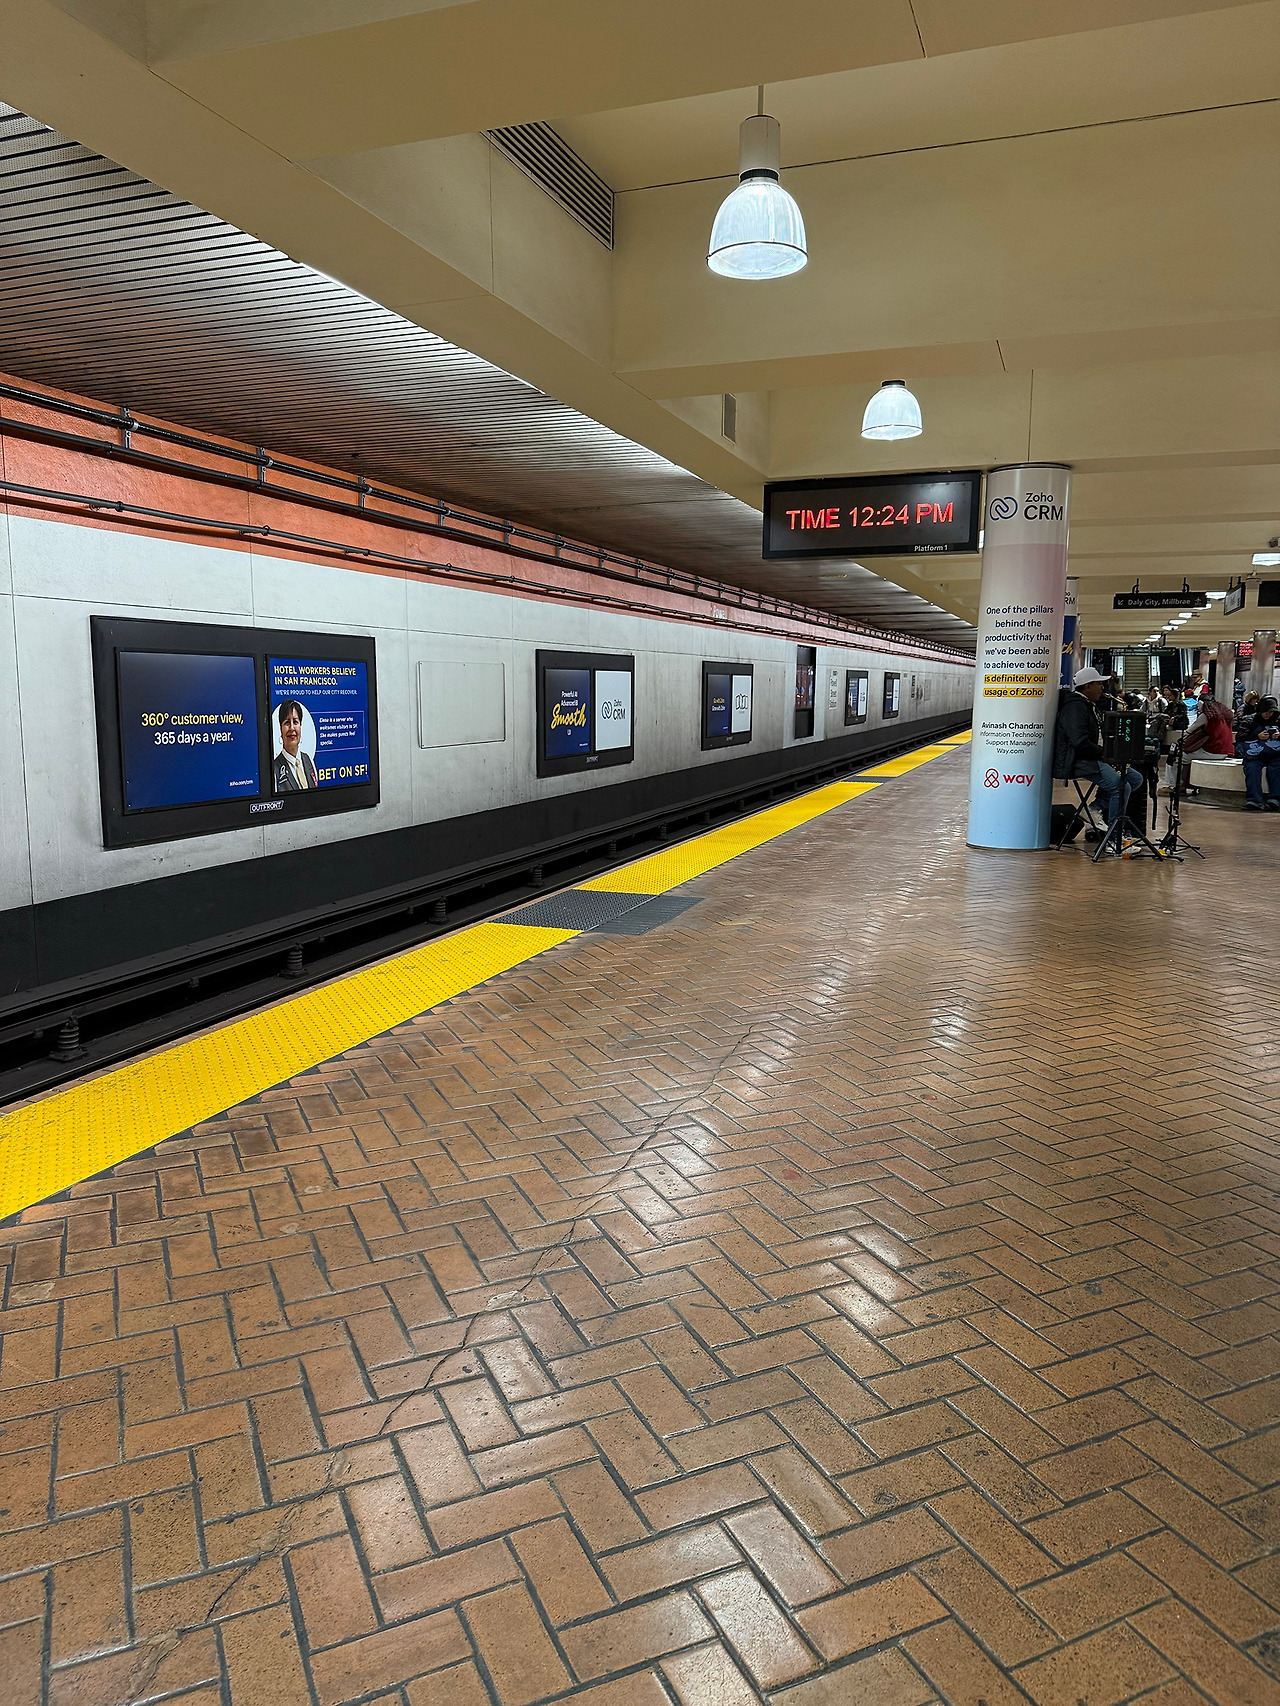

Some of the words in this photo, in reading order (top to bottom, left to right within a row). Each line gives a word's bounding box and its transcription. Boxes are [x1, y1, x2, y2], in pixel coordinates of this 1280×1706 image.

[1025, 492, 1054, 502] Zoho
[785, 508, 840, 530] TIME
[849, 504, 909, 527] 12:24
[916, 502, 954, 524] PM
[1024, 505, 1063, 520] CRM
[1064, 597, 1076, 605] RM
[1128, 599, 1143, 607] Daly
[1144, 599, 1161, 607] City,
[986, 606, 1001, 615] One
[1002, 605, 1011, 613] of
[1013, 605, 1027, 613] the
[1030, 605, 1054, 614] pillars
[995, 619, 1025, 628] behind
[1027, 619, 1042, 627] the
[985, 633, 1035, 643] productivity
[1036, 633, 1051, 641] that
[985, 647, 1006, 655] we've
[1032, 647, 1050, 655] able
[992, 661, 1025, 669] achieve
[1026, 661, 1049, 669] today
[274, 665, 297, 674] HOTEL
[298, 666, 330, 675] WORKERS
[331, 667, 356, 676] BELIEVE
[274, 677, 283, 685] IN
[284, 677, 298, 685] SAN
[300, 677, 338, 686] FRANCISCO.
[984, 674, 990, 682] is
[991, 674, 1032, 683] definitely
[984, 688, 1008, 697] usage
[1009, 688, 1019, 696] of
[1021, 688, 1044, 696] Zoho.
[141, 712, 169, 727] 360°
[171, 713, 219, 725] customer
[220, 711, 244, 725] view,
[551, 703, 586, 729] Smooth
[613, 708, 626, 720] CRM
[154, 731, 175, 745] 365
[177, 731, 201, 745] days
[203, 733, 209, 742] a
[210, 731, 234, 744] year.
[985, 739, 1009, 747] Support
[319, 767, 336, 780] BET
[339, 766, 353, 778] ON
[354, 764, 368, 777] SF!
[1003, 774, 1034, 787] way
[251, 802, 282, 812] OUTFRONT
